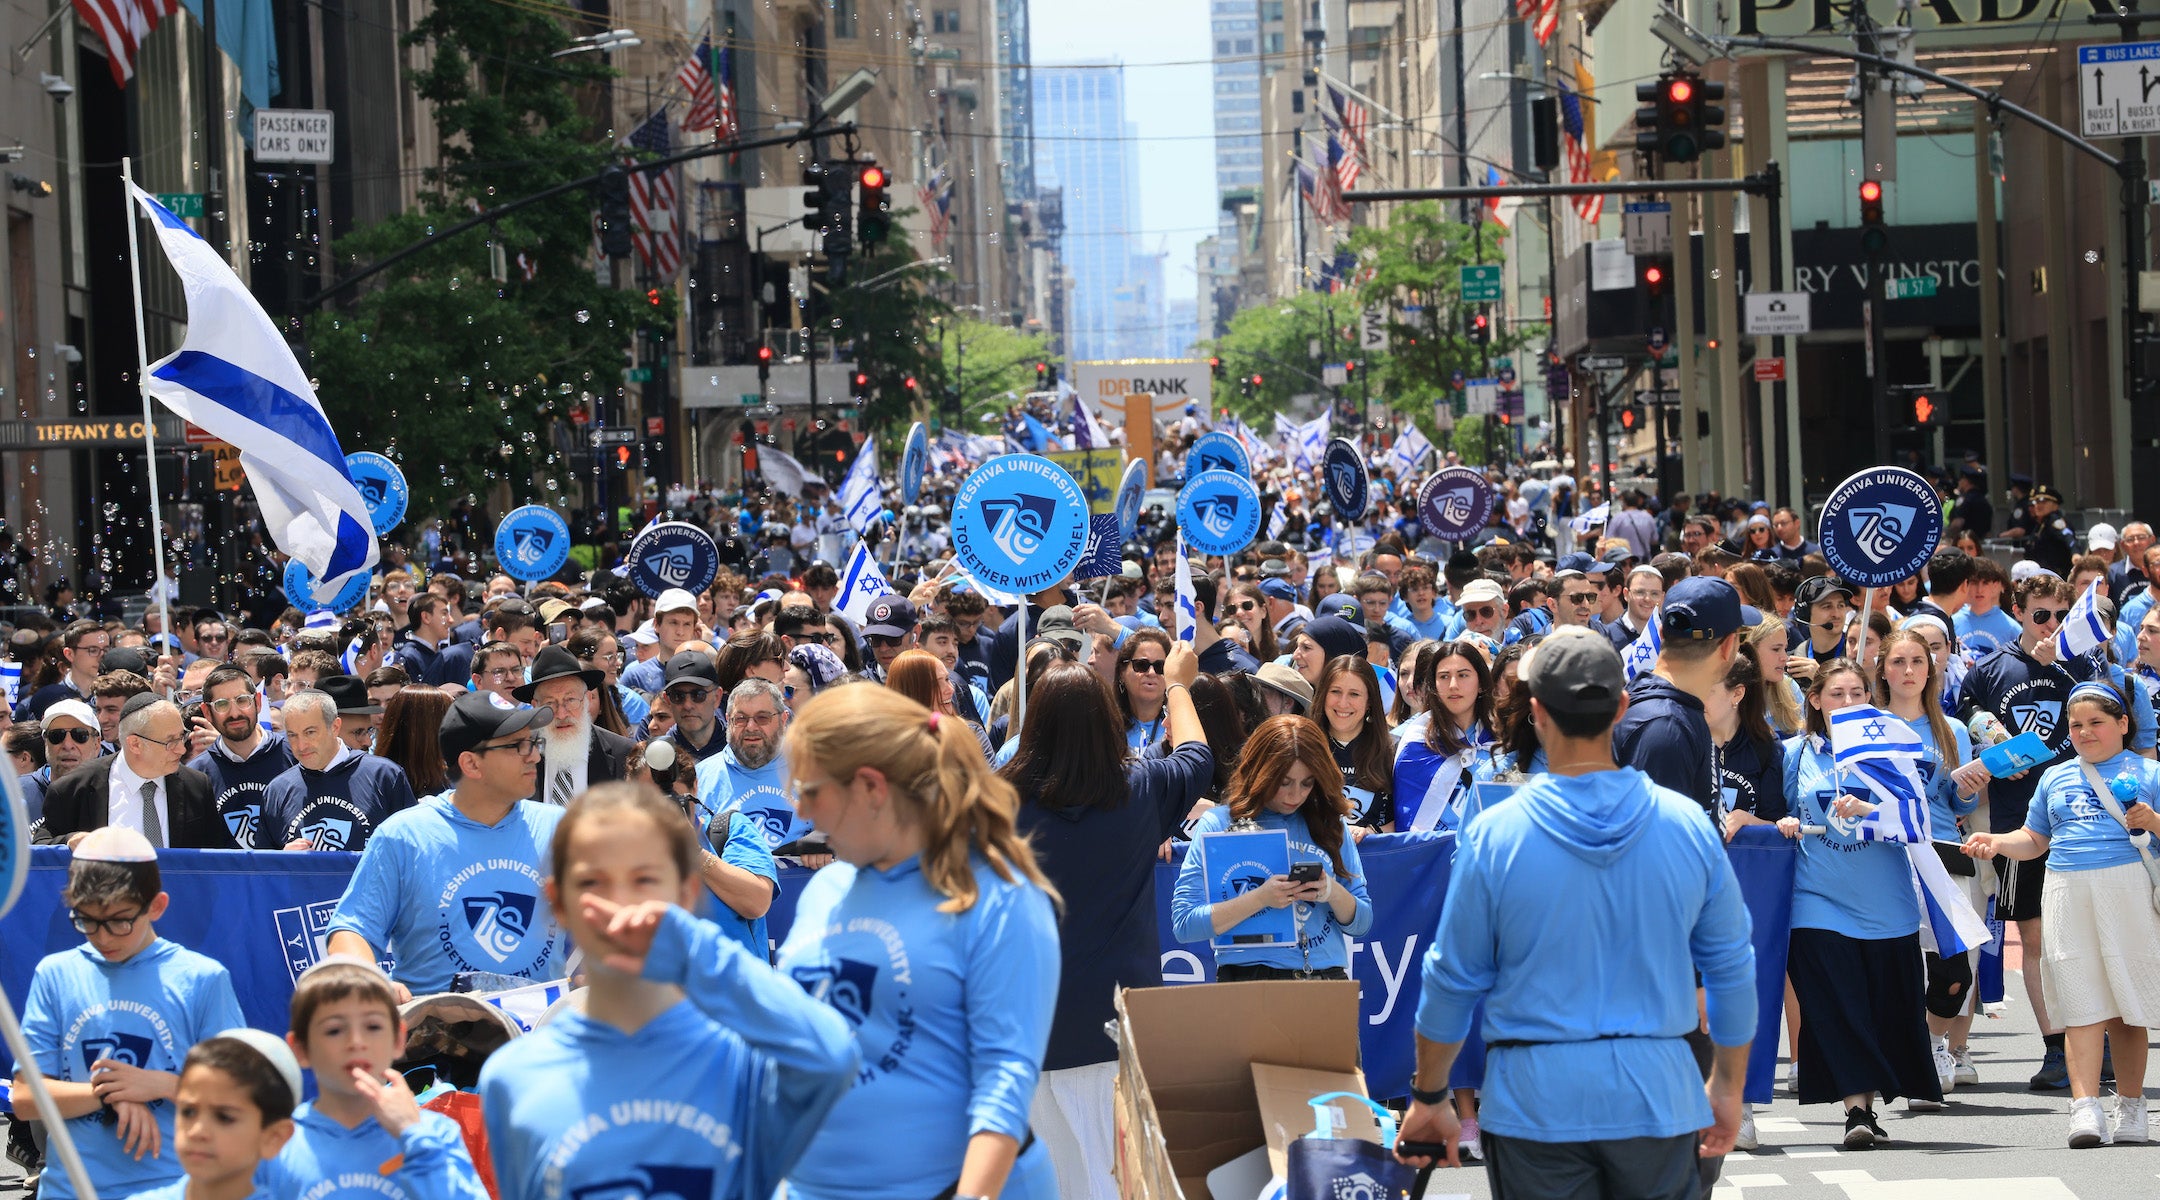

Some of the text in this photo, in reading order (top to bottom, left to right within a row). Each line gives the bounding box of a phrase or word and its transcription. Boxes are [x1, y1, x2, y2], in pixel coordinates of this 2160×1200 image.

[2105, 48, 2126, 60] BUS
[259, 116, 328, 133] PASSENGER
[2087, 108, 2114, 120] BUSES
[2090, 121, 2112, 132] ONLY
[2127, 106, 2154, 118] BUSES
[2131, 117, 2156, 130] RIGHT
[259, 136, 328, 153] CARS ONLY
[170, 198, 187, 218] 57
[1898, 278, 1909, 296] W
[1911, 278, 1925, 295] 57
[35, 422, 109, 441] TIFFANY
[113, 421, 128, 439] &
[956, 463, 1005, 511] YESHIVA
[1007, 460, 1081, 508] UNIVERSITY
[1178, 476, 1206, 510] YESHIVA
[1205, 473, 1254, 501] UNIVERSITY
[1420, 471, 1488, 509] YESHIVA UNIVERSITY
[1826, 474, 1938, 518] YESHIVA UNIVERSITY
[500, 507, 567, 539] YESHIVA UNIVERSITY
[1180, 506, 1258, 553] TOGETHER WITH ISRAEL
[1421, 493, 1493, 541] TOGETHER WITH ISRAEL
[496, 541, 568, 579] TOGETHER WITH ISRAEL
[629, 527, 709, 569] YESHIVA UNIVERSITY
[956, 525, 1010, 587] TOGETHER
[1014, 569, 1052, 588] WITH
[1053, 522, 1084, 574] ISRAEL
[1823, 526, 1939, 584] TOGETHER WITH ISRAEL
[702, 549, 719, 586] ISRAEL
[286, 572, 369, 612] TOGETHER ISRAEL
[2000, 682, 2030, 716] YESHIVA
[287, 795, 371, 841] YESHIVA UNIVERSITY
[1842, 840, 1871, 853] WITH
[438, 861, 486, 910] YESHIVA
[1221, 862, 1242, 886] YESHIVA
[63, 1000, 175, 1052] YESHIVA UNIVERSITY
